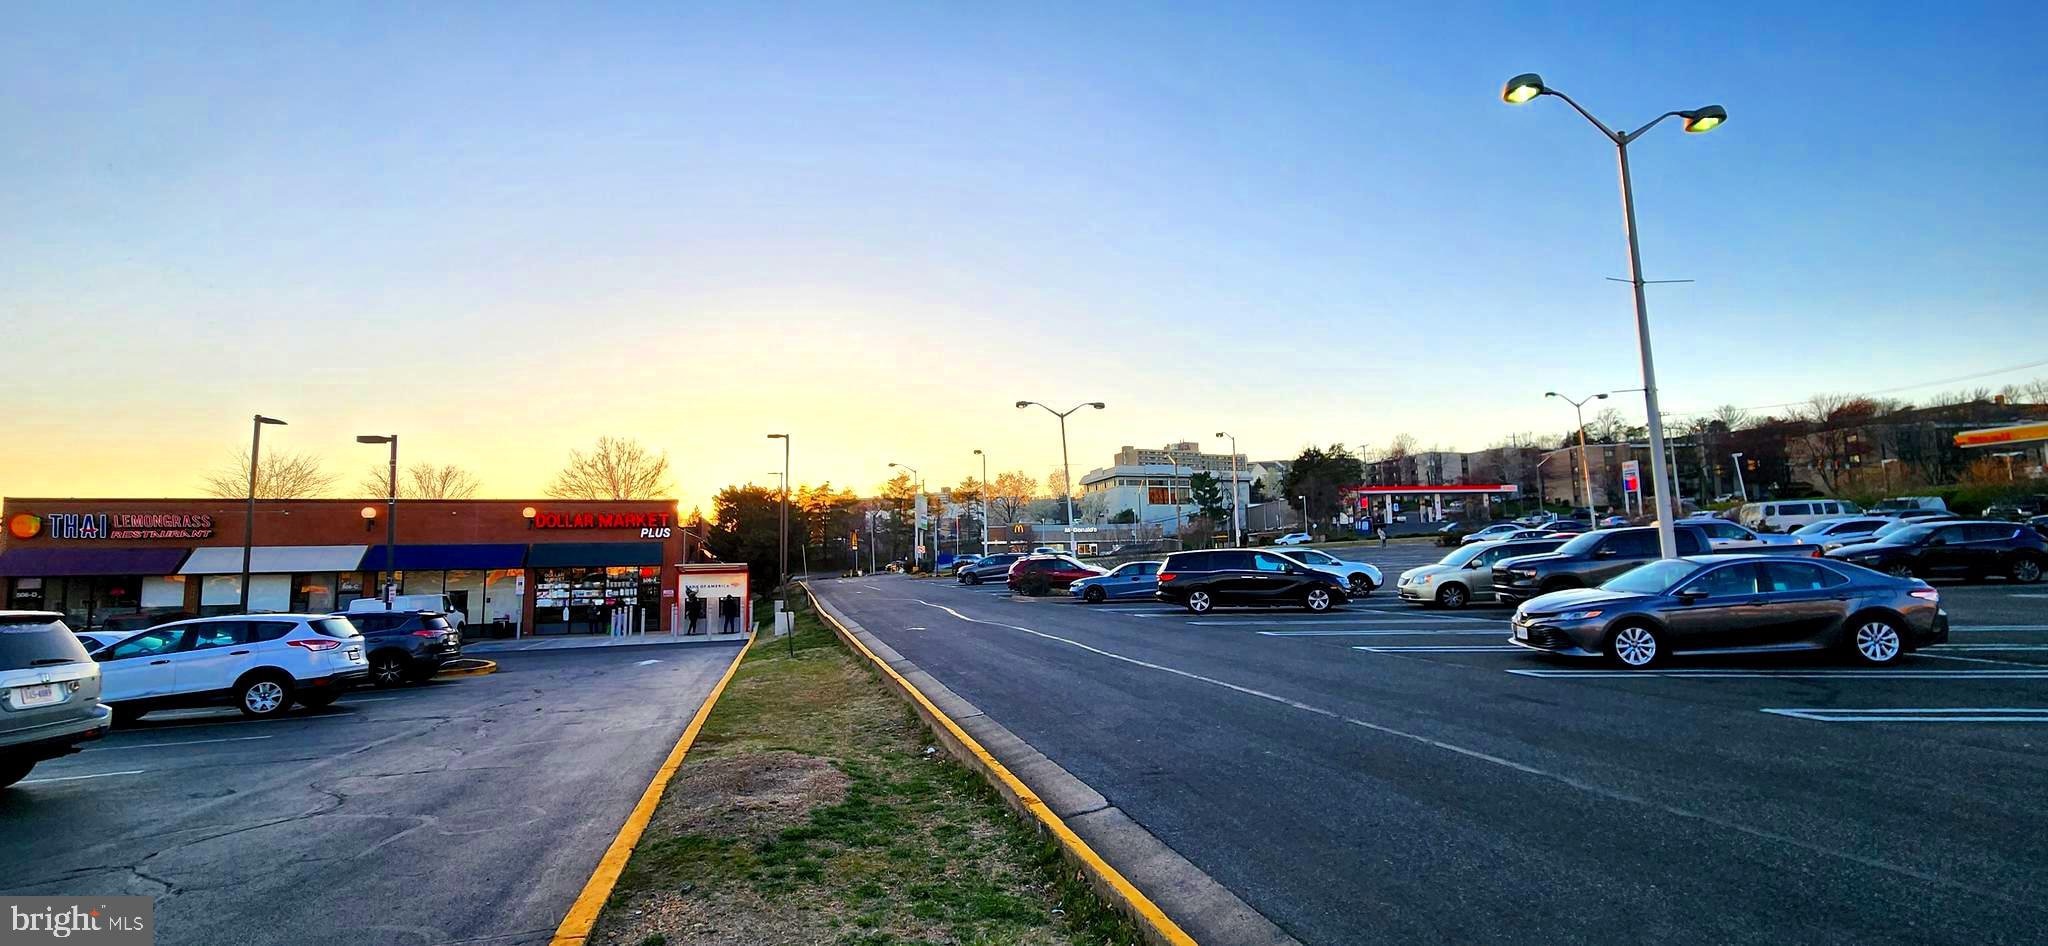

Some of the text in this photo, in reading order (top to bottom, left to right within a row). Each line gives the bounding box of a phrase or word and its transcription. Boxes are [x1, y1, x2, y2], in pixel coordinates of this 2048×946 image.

[48, 513, 212, 539] THAI LEMONGRASS
[535, 512, 670, 528] DOLLAR MARKET
[110, 529, 212, 539] RESTAURANT
[640, 528, 671, 538] PLUS
